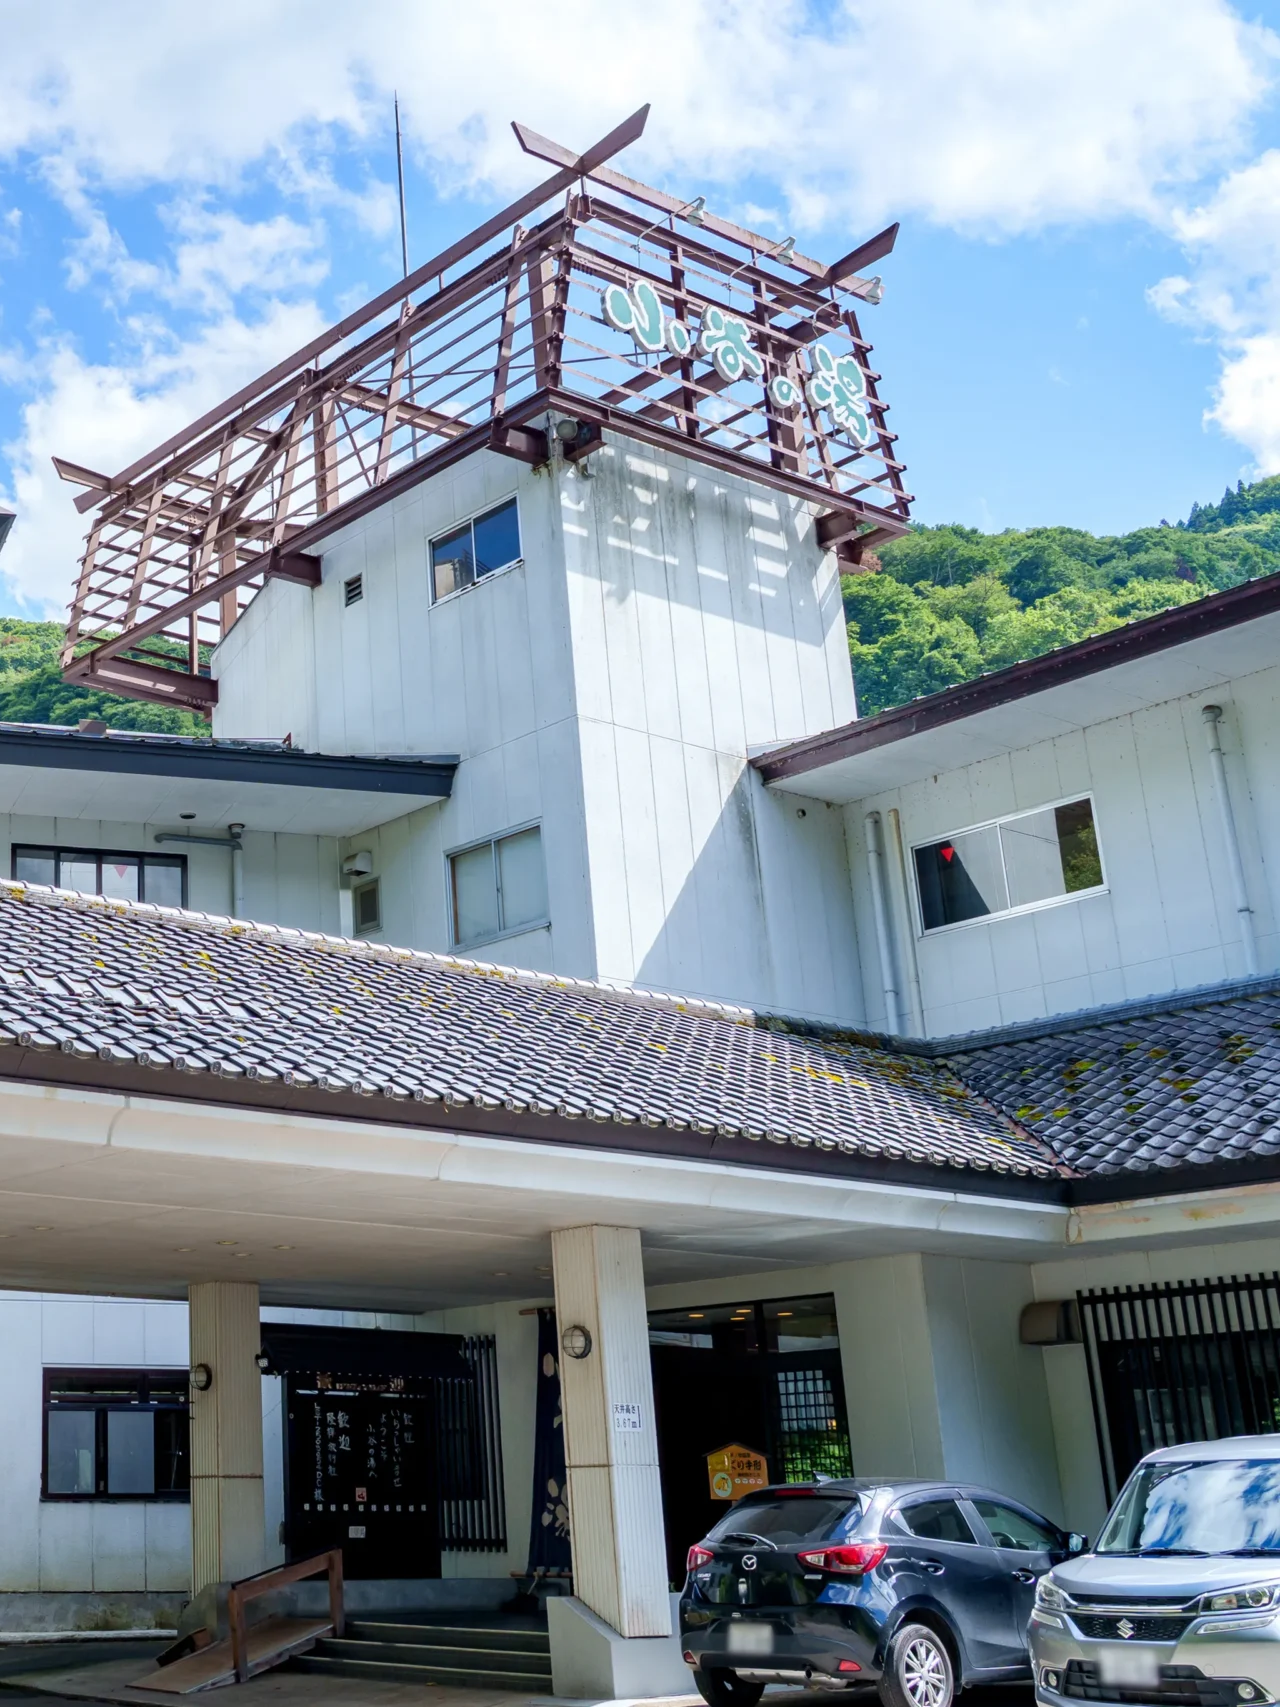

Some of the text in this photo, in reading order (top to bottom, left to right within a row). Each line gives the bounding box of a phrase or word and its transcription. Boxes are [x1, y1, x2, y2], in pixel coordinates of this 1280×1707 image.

[601, 279, 871, 448] 小谷の湯
[614, 1404, 636, 1414] 天井高さ
